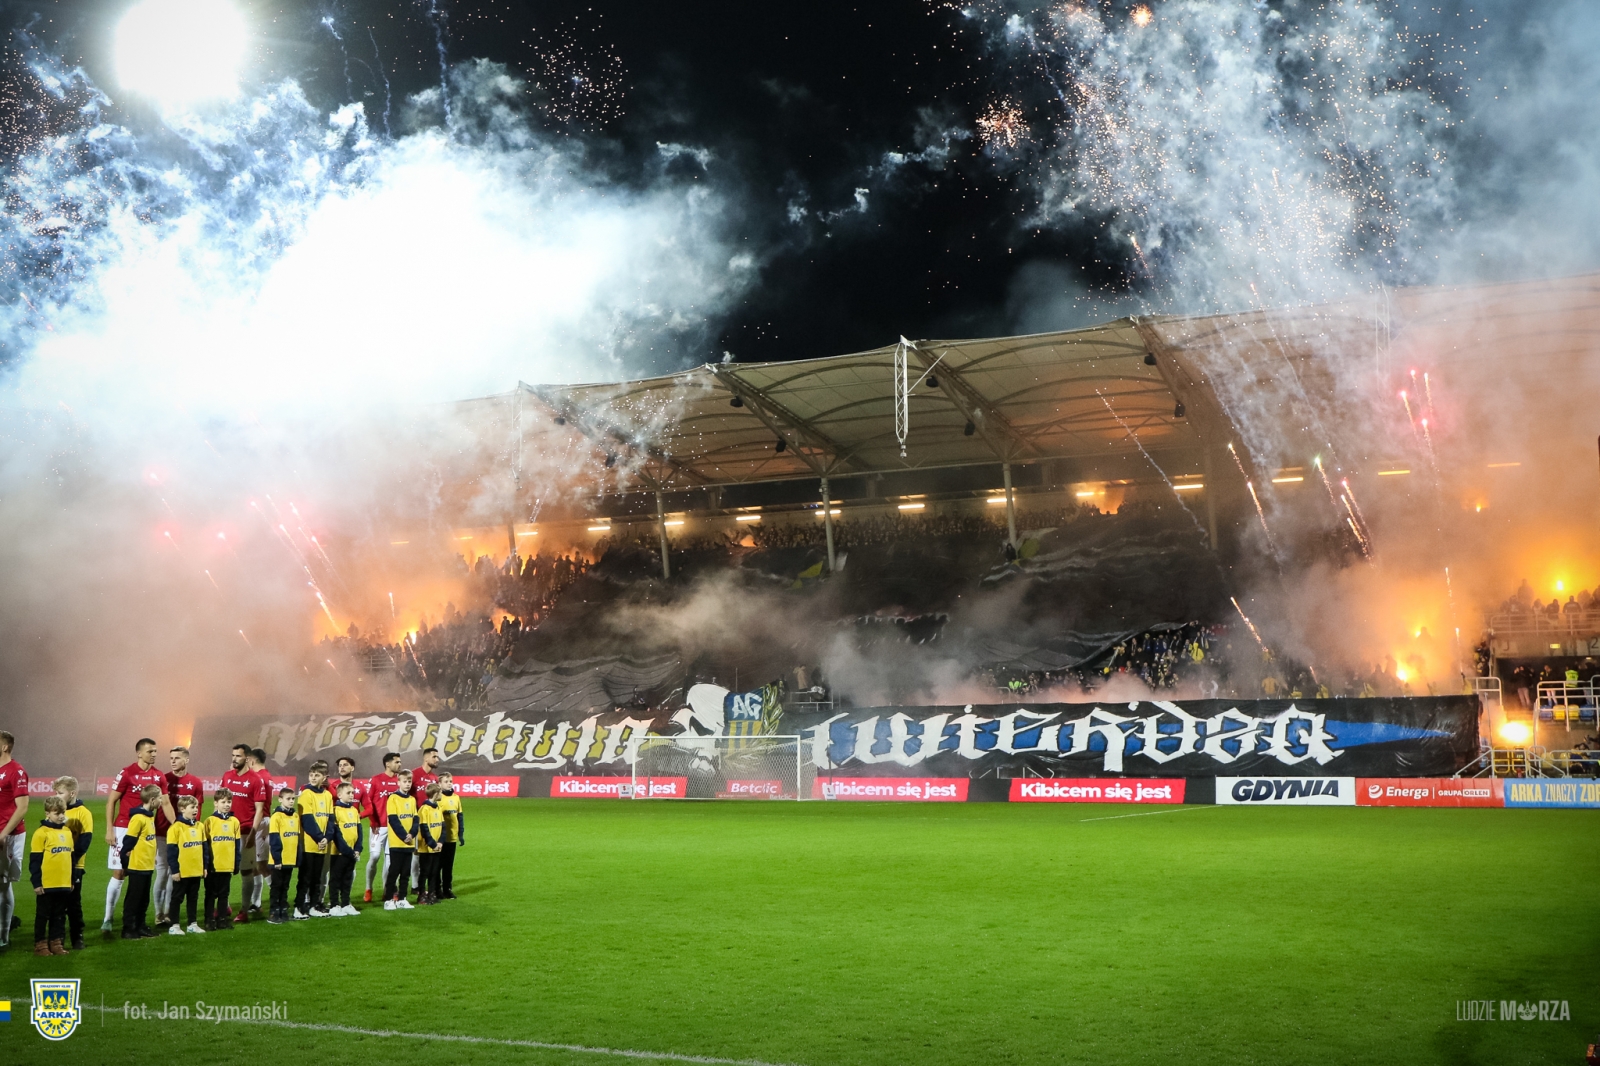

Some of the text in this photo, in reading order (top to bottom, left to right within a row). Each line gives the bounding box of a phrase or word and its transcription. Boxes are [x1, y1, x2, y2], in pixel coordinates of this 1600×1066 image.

[732, 692, 762, 720] AG
[28, 781, 54, 793] Kibi
[462, 780, 482, 795] się
[483, 780, 510, 795] jest
[648, 780, 677, 797] jest
[730, 783, 778, 794] Betclic
[896, 782, 922, 798] się
[923, 782, 957, 799] jest
[1020, 782, 1172, 801] Kibicem się jest
[1231, 779, 1339, 802] GDYNIA
[1386, 785, 1429, 800] Energa
[1463, 789, 1490, 797] ORLEN
[1511, 783, 1543, 802] ARKA
[1544, 783, 1577, 802] ZNACZY
